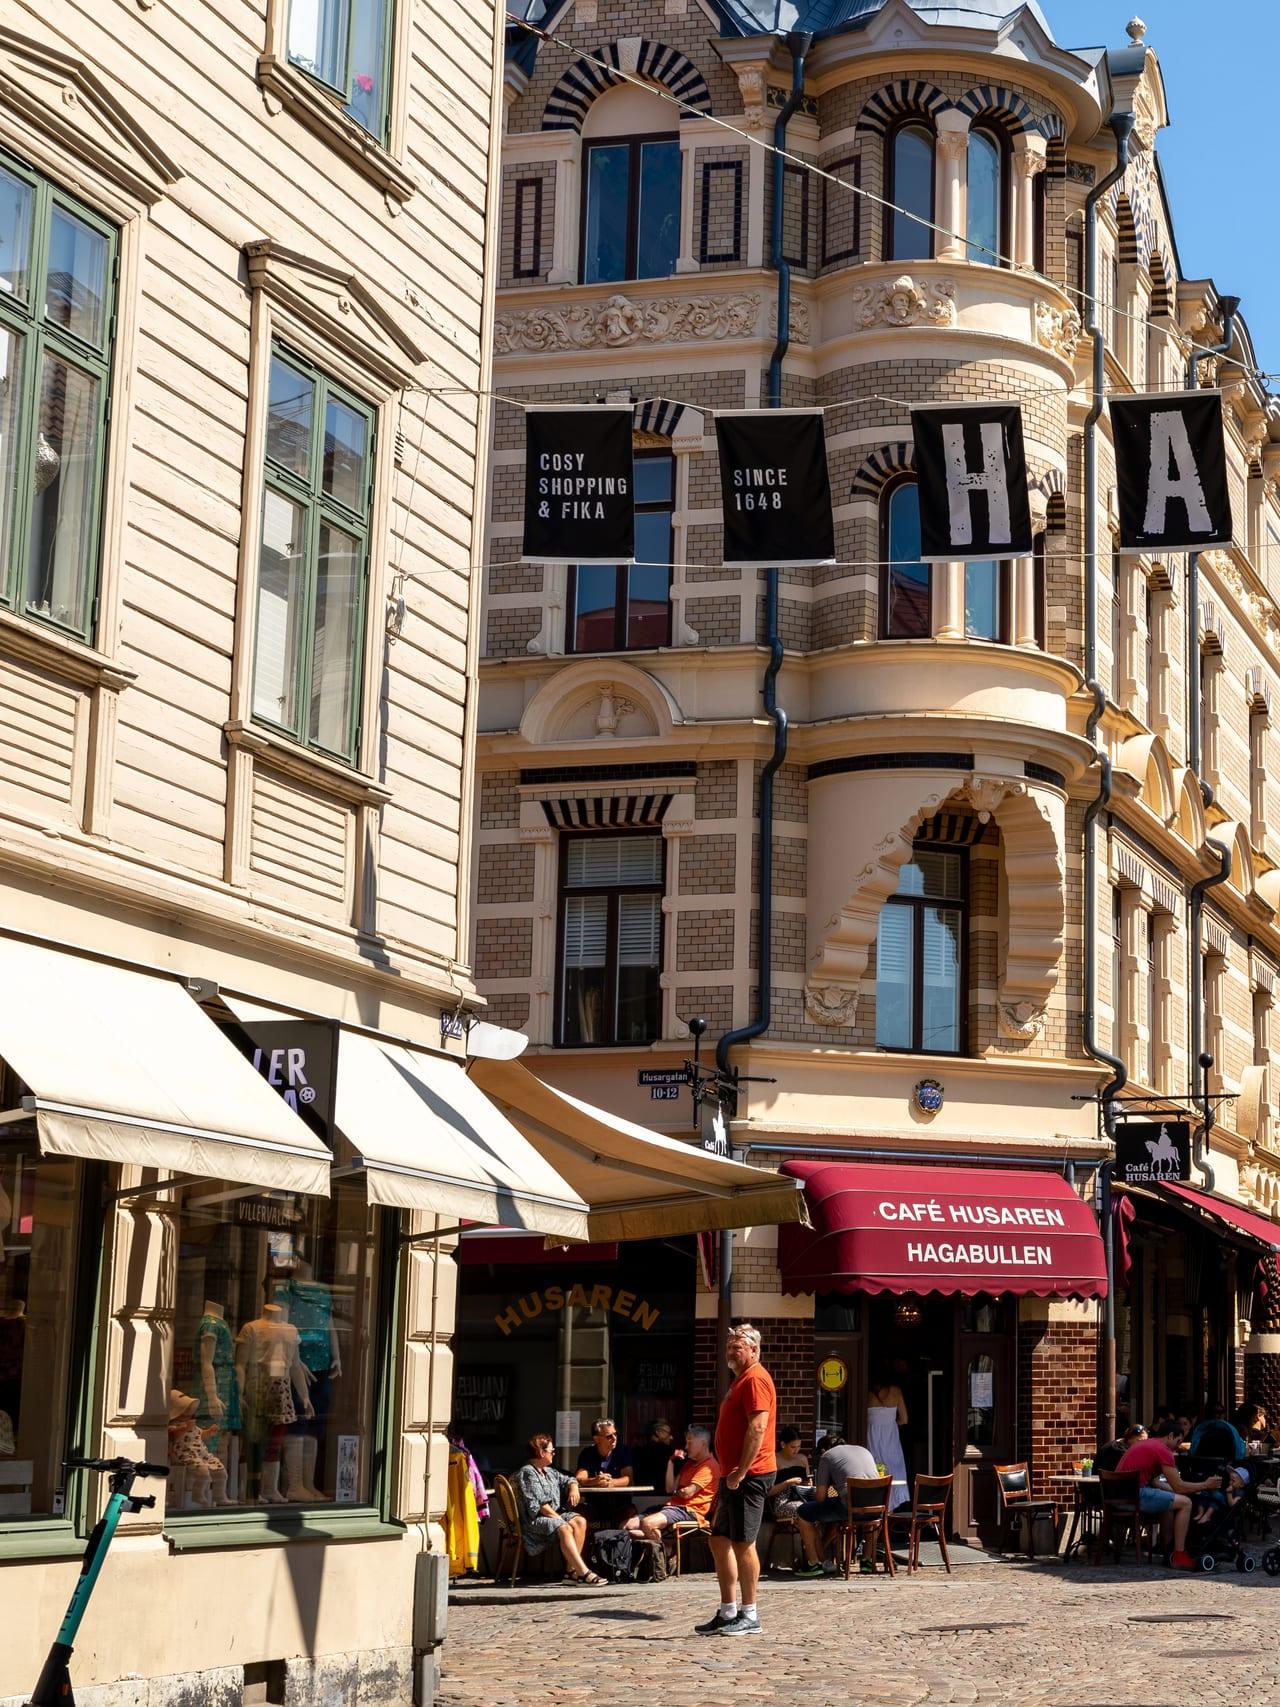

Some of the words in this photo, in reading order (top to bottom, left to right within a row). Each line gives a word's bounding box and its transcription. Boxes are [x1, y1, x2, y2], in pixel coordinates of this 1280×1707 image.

[540, 453, 585, 471] COSY
[539, 477, 627, 496] SHOPPING
[734, 468, 788, 487] SINCE
[538, 500, 550, 518] &
[561, 501, 605, 519] FIKA
[735, 491, 782, 511] 1648
[642, 1073, 688, 1083] Husargatan
[1125, 1162, 1149, 1172] Café
[1125, 1172, 1181, 1182] HUSAREN
[879, 1199, 946, 1223] CAFÉ
[949, 1205, 1065, 1227] HUSAREN
[907, 1242, 1052, 1265] HAGABULLEN
[495, 1283, 661, 1337] HUSAREN
